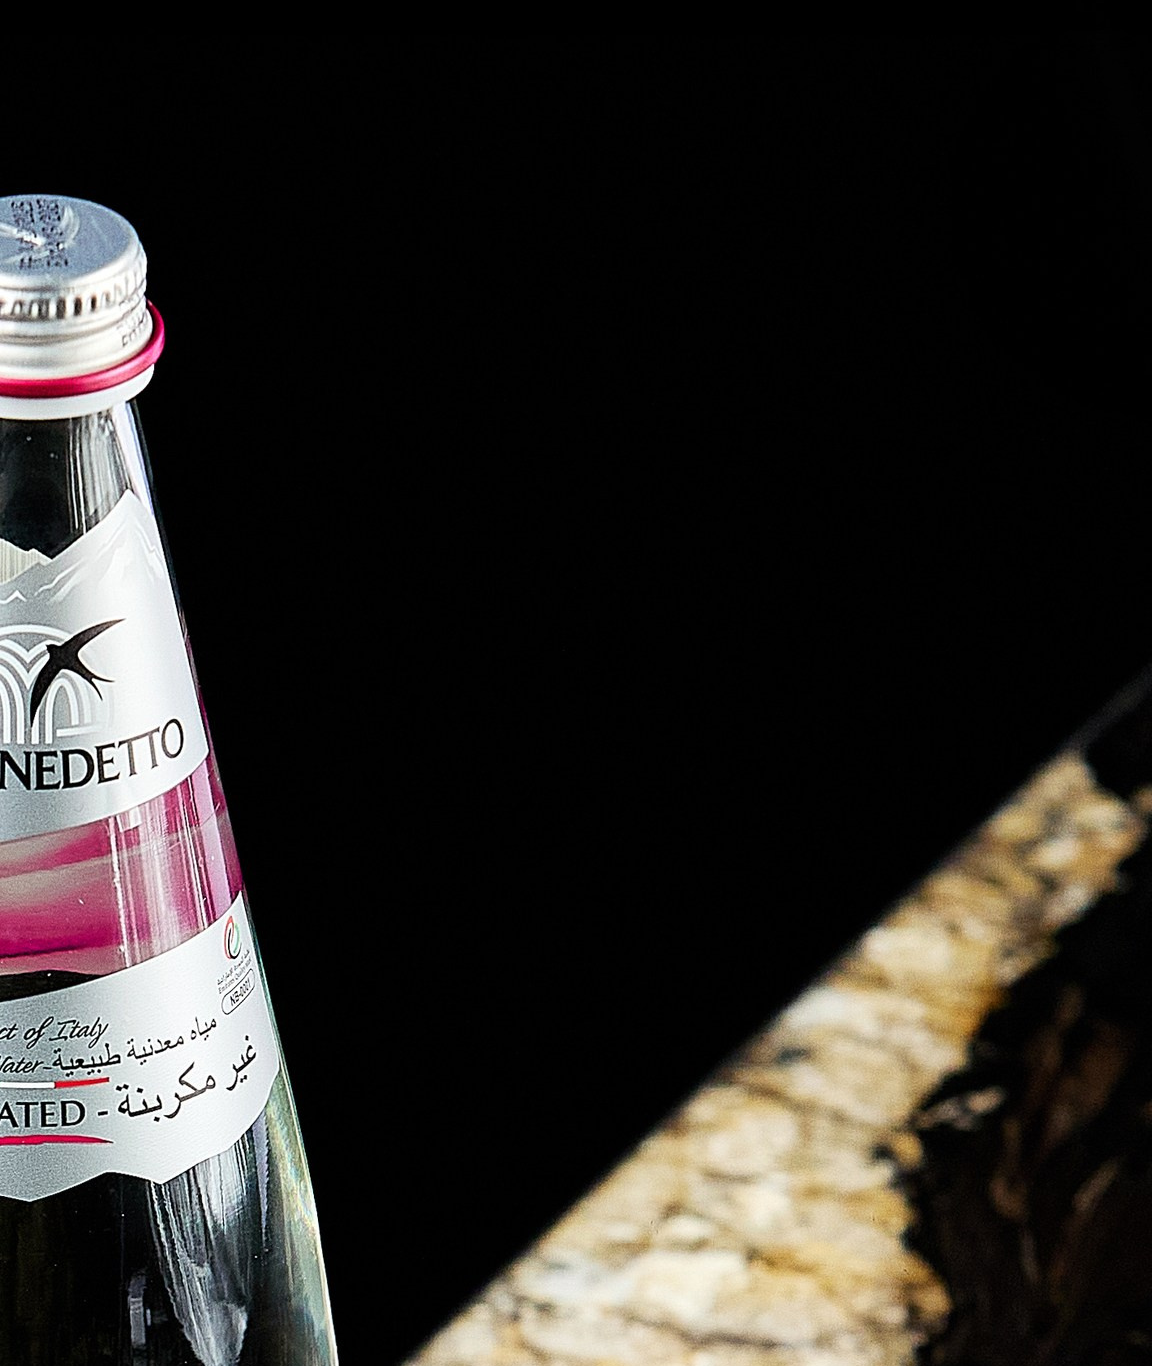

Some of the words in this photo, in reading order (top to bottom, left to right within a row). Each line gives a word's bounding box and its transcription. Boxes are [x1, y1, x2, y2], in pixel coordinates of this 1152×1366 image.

[24, 1016, 54, 1049] of
[49, 1017, 109, 1048] Italy
[190, 1017, 217, 1041] مياه
[52, 1043, 122, 1077] طبيعية
[126, 1035, 185, 1065] معدنية
[226, 1034, 257, 1091] غير
[115, 1062, 216, 1122] مكربنة
